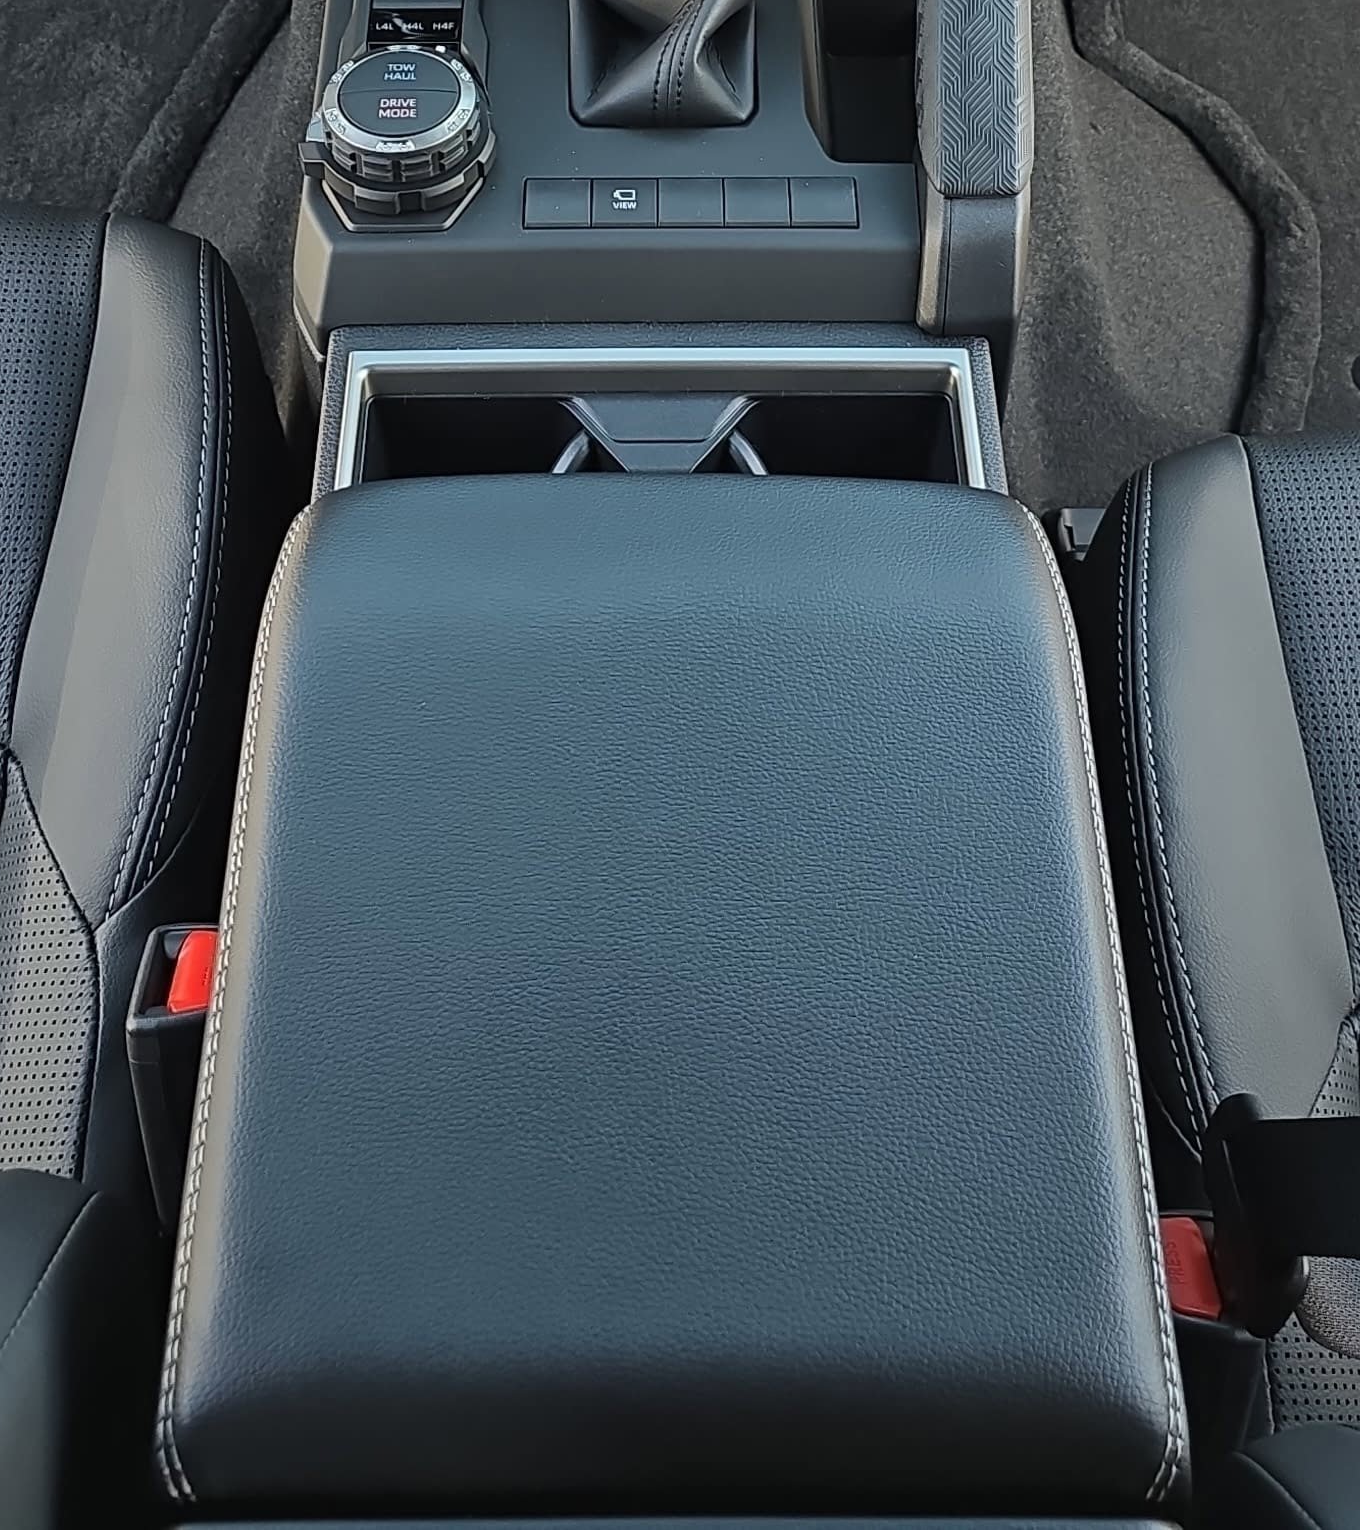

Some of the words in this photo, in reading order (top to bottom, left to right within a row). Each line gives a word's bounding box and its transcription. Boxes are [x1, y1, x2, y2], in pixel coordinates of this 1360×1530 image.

[384, 72, 416, 80] HAUL
[380, 99, 416, 108] DRIVE
[378, 108, 417, 118] MODE
[612, 201, 637, 210] VIEW
